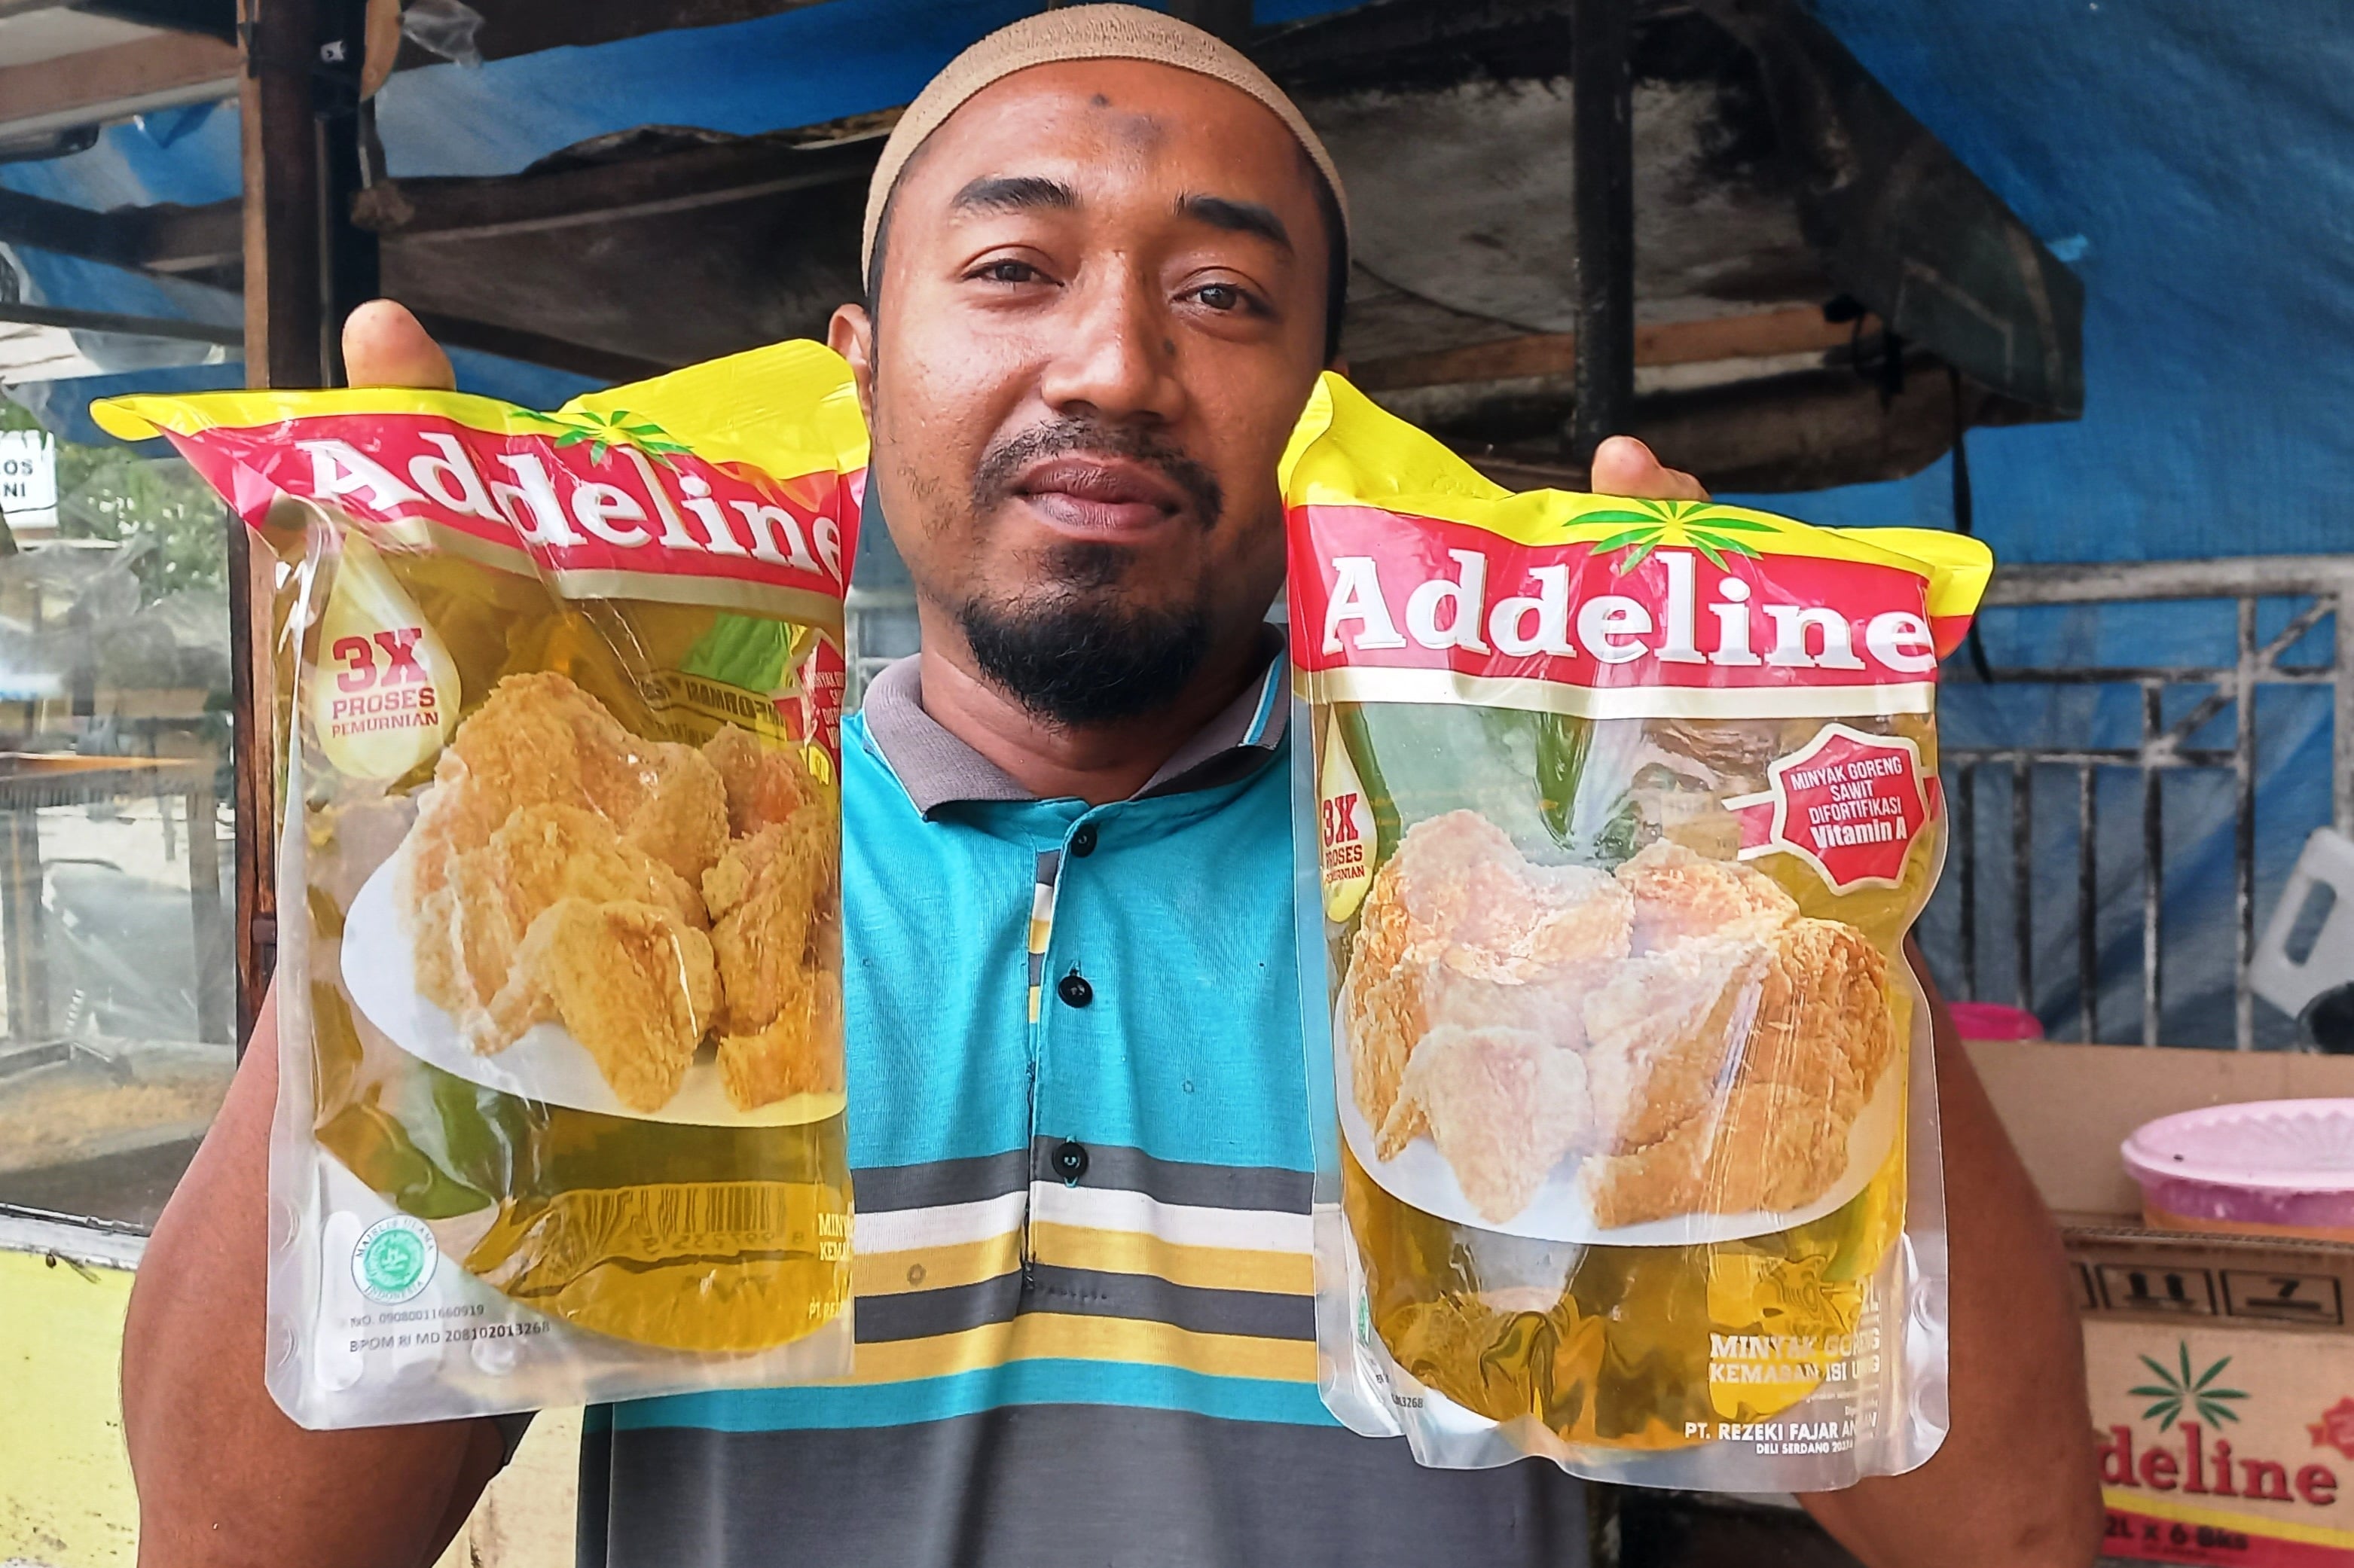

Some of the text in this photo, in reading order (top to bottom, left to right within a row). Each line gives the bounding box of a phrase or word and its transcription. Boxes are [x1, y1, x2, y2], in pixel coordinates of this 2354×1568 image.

[0, 459, 33, 476] OS
[1320, 548, 1937, 673] Addeline
[332, 627, 428, 693] 3X
[332, 687, 435, 720] PROSES
[331, 712, 438, 738] PEMURNIAN
[1790, 756, 1903, 791] MINYAK GORENG
[1830, 780, 1873, 802] SAWIT
[1324, 792, 1359, 848] 3X
[1808, 796, 1903, 825] DIFORTIFIKASI
[1809, 816, 1908, 849] Vitamin A
[350, 1335, 395, 1353] BPOM
[416, 1332, 441, 1345] MD
[1710, 1332, 1817, 1359] MINYAK
[1709, 1362, 1819, 1383] KEMASAN
[1824, 1360, 1847, 1382] ISI
[1684, 1421, 1711, 1440] PT.
[1718, 1422, 1784, 1441] REZEKI
[1789, 1420, 1839, 1441] FAJAR
[1756, 1441, 1778, 1454] DELI
